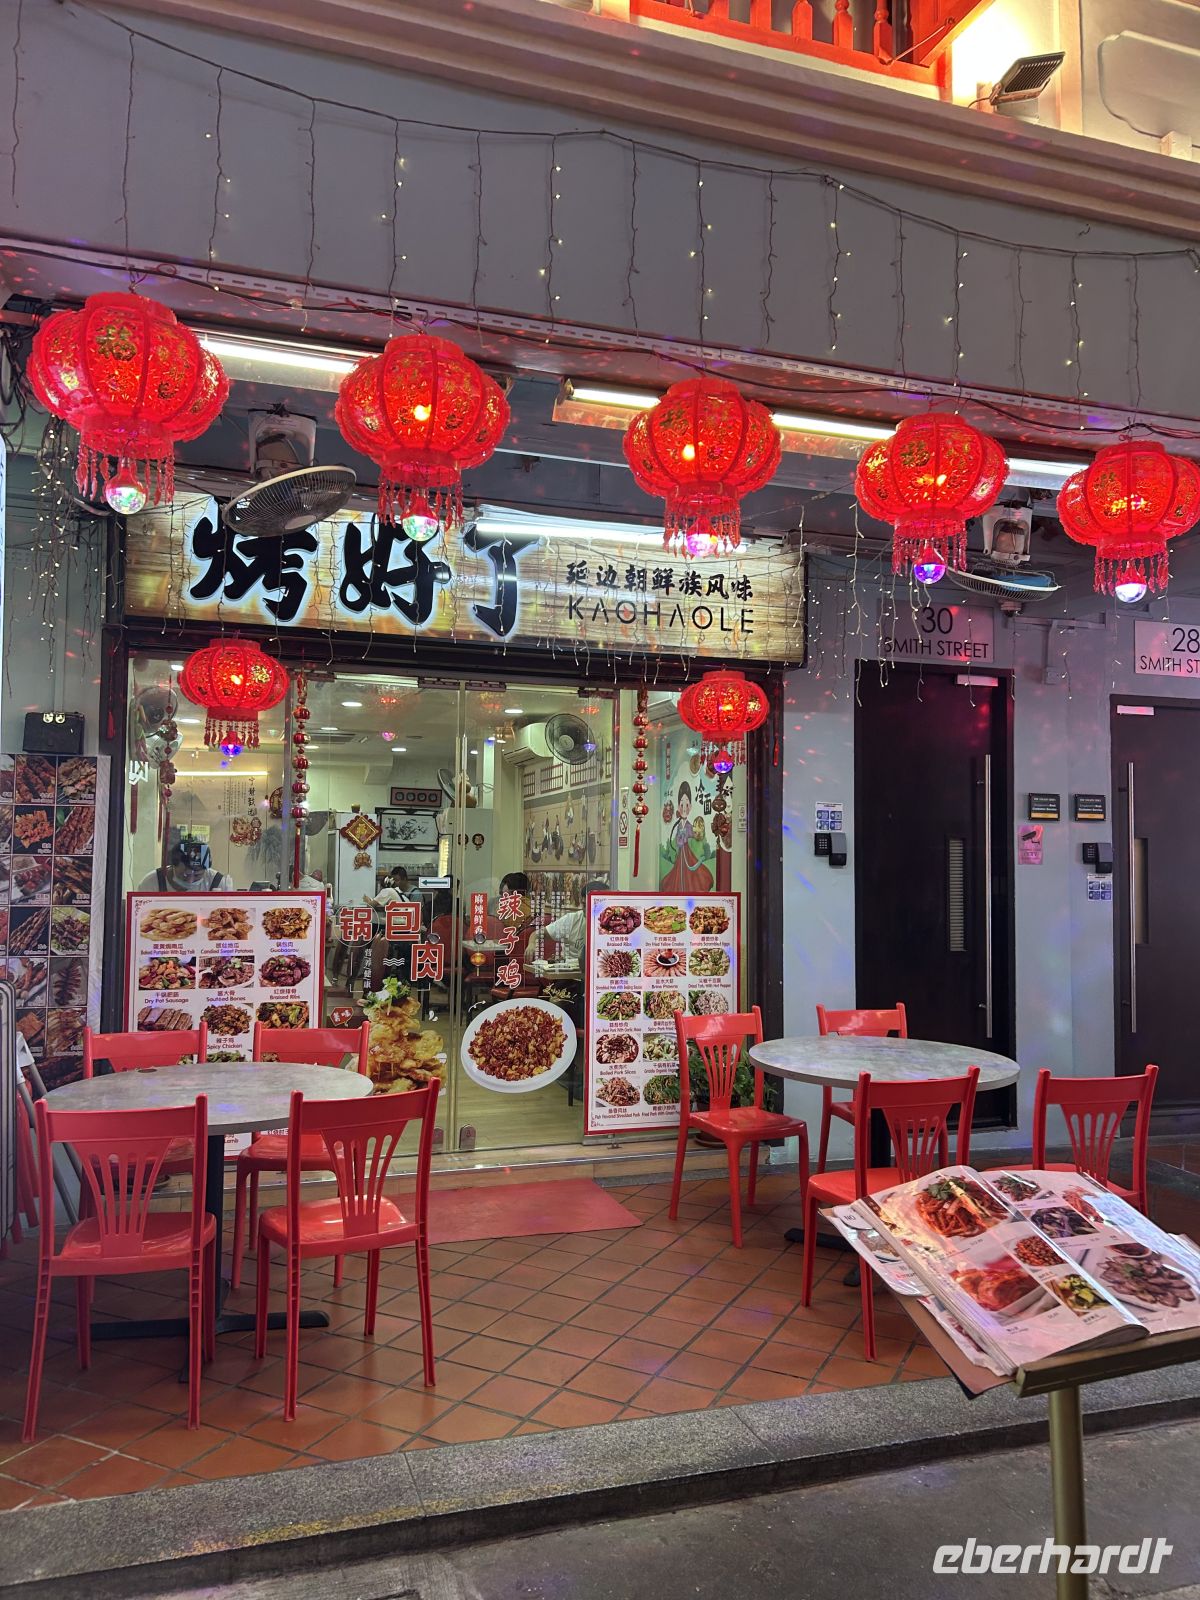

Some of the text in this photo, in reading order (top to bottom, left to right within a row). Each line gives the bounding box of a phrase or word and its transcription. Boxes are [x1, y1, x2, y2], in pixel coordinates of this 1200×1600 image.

[566, 560, 754, 602] 延边朝鲜族风味
[921, 606, 954, 635] 30
[884, 637, 990, 659] SMITH STREET
[1172, 627, 1200, 654] 28
[1140, 655, 1182, 673] SMITH
[495, 890, 525, 990] 辣子鸡
